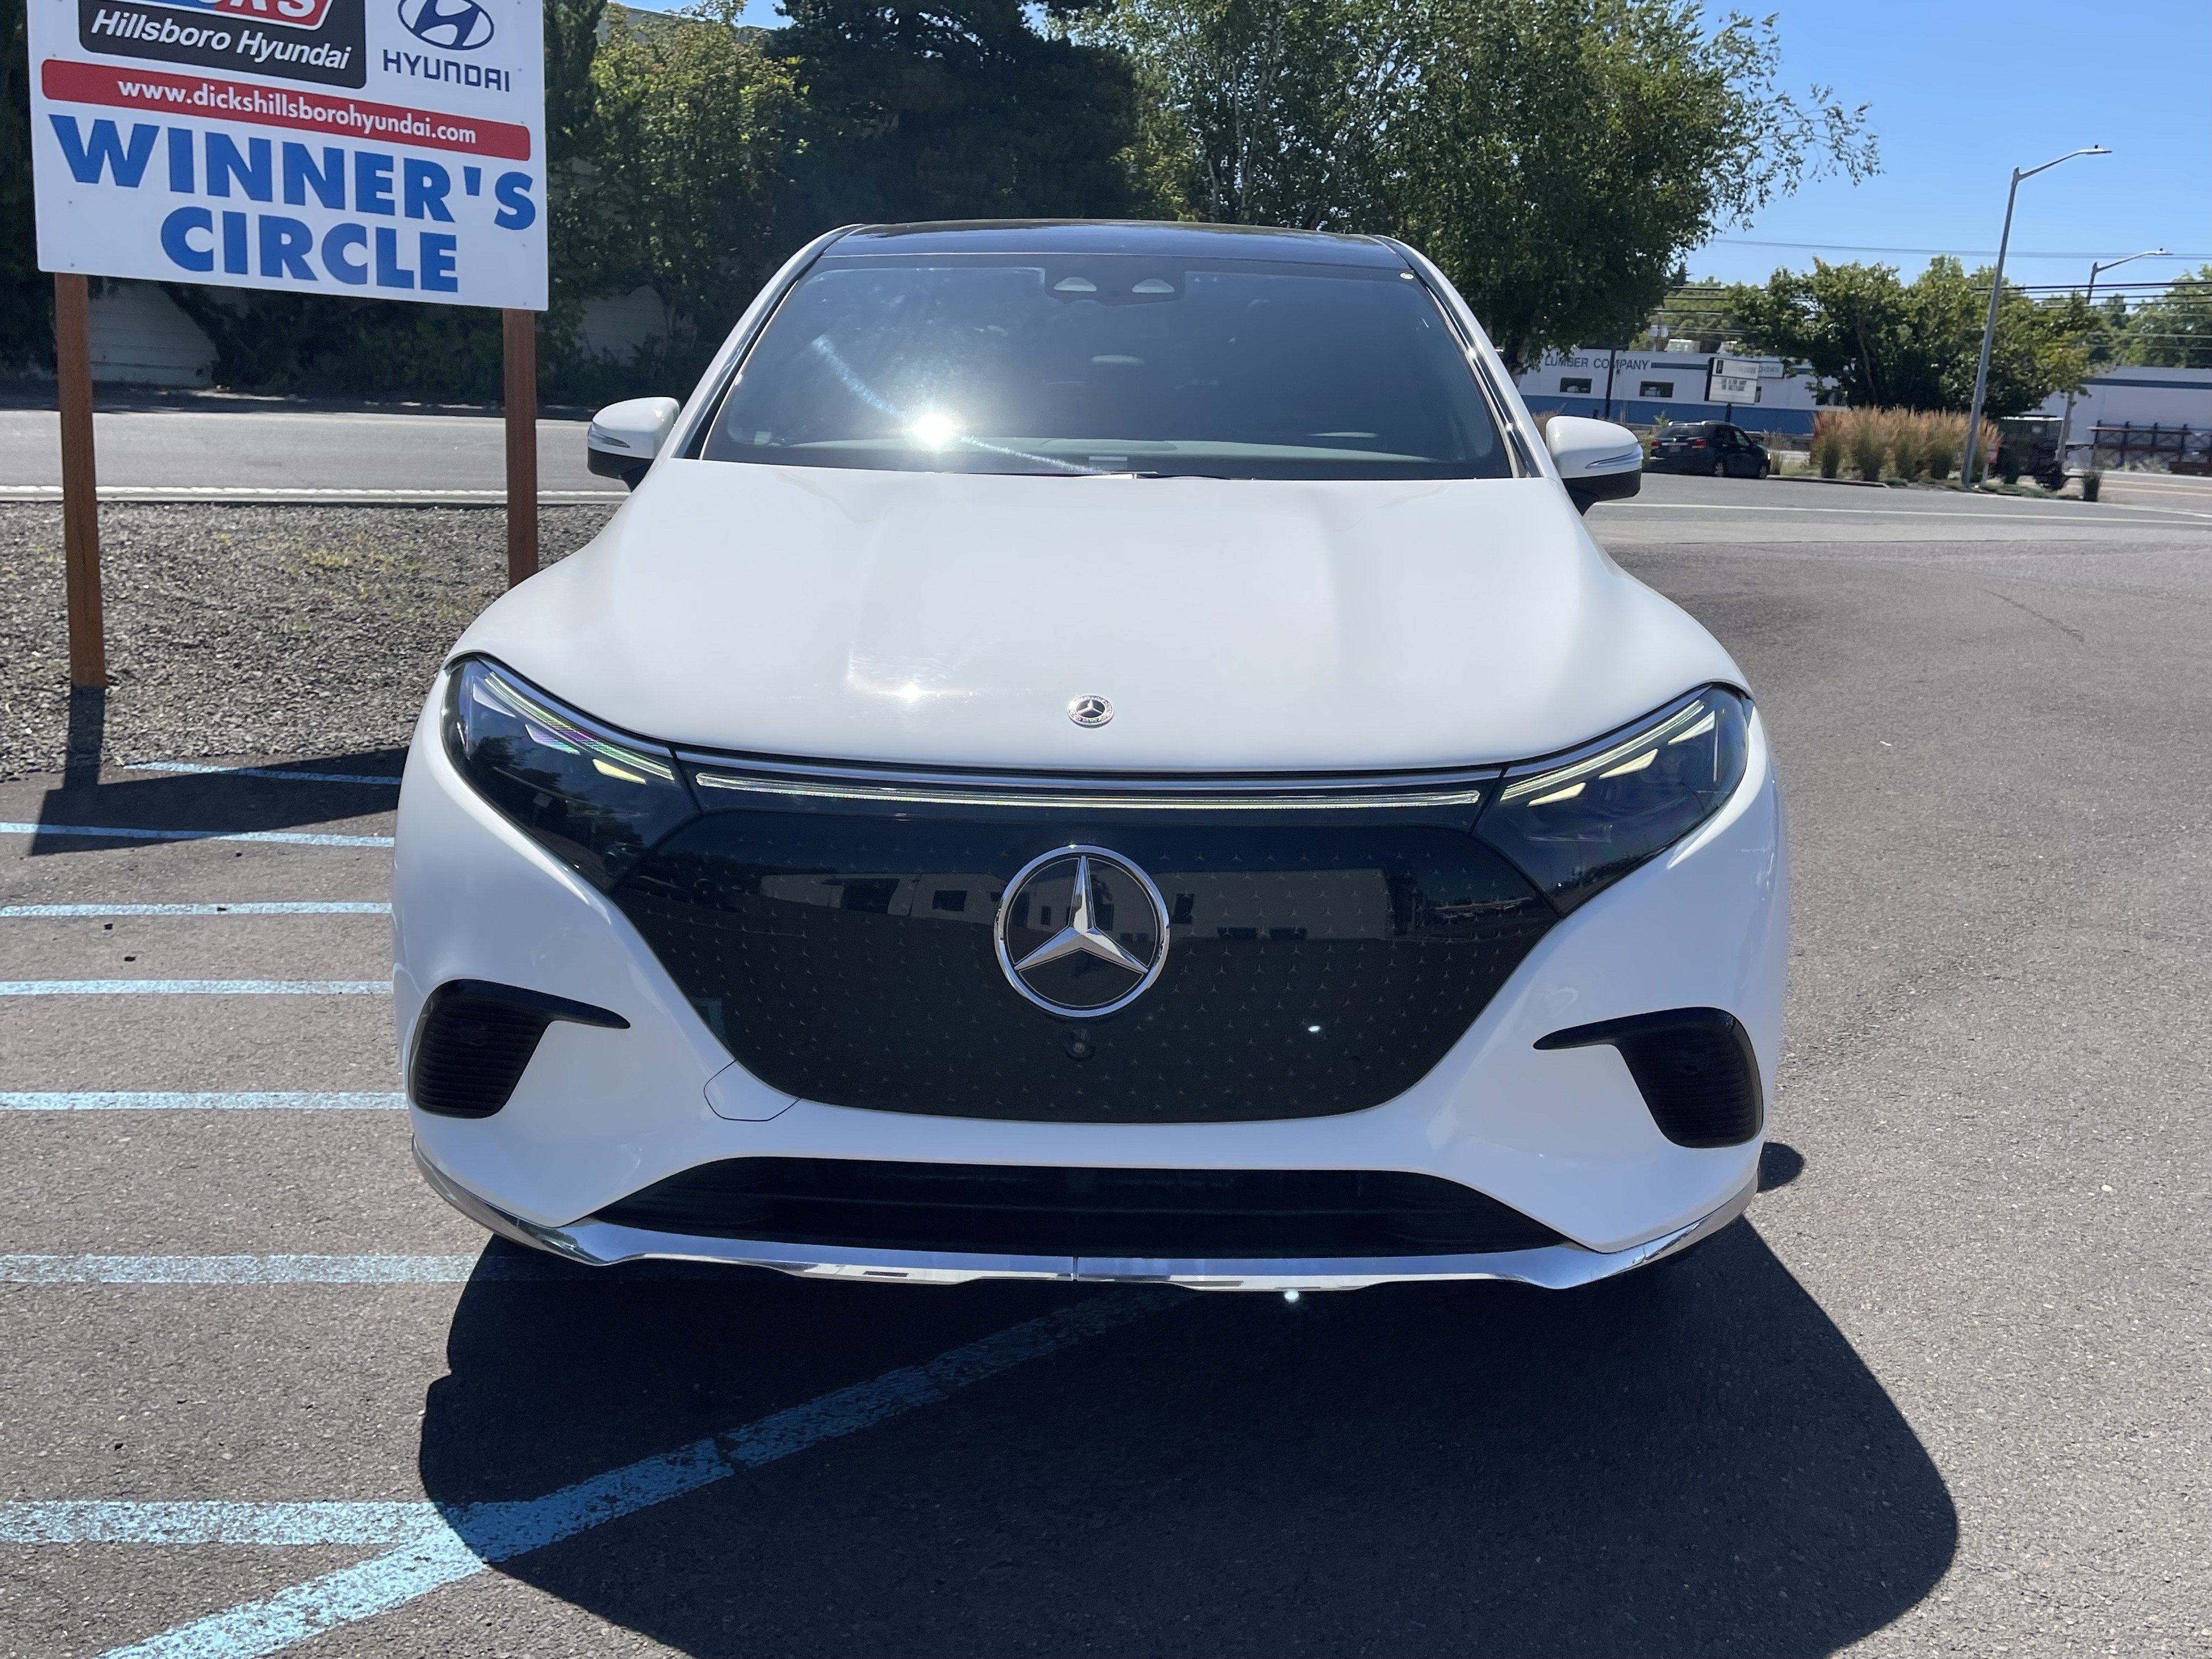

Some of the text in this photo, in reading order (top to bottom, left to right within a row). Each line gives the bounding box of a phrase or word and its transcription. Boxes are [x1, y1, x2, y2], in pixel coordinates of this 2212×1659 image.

[91, 9, 230, 50] Hillsboro
[236, 30, 352, 70] Hyundai
[383, 49, 510, 92] HYUNDAI
[117, 78, 476, 144] www.dickshillsborohyundai.com
[48, 114, 537, 230] WINNER'S
[161, 206, 458, 293] CIRCLE
[1544, 356, 1588, 368] LUMBER
